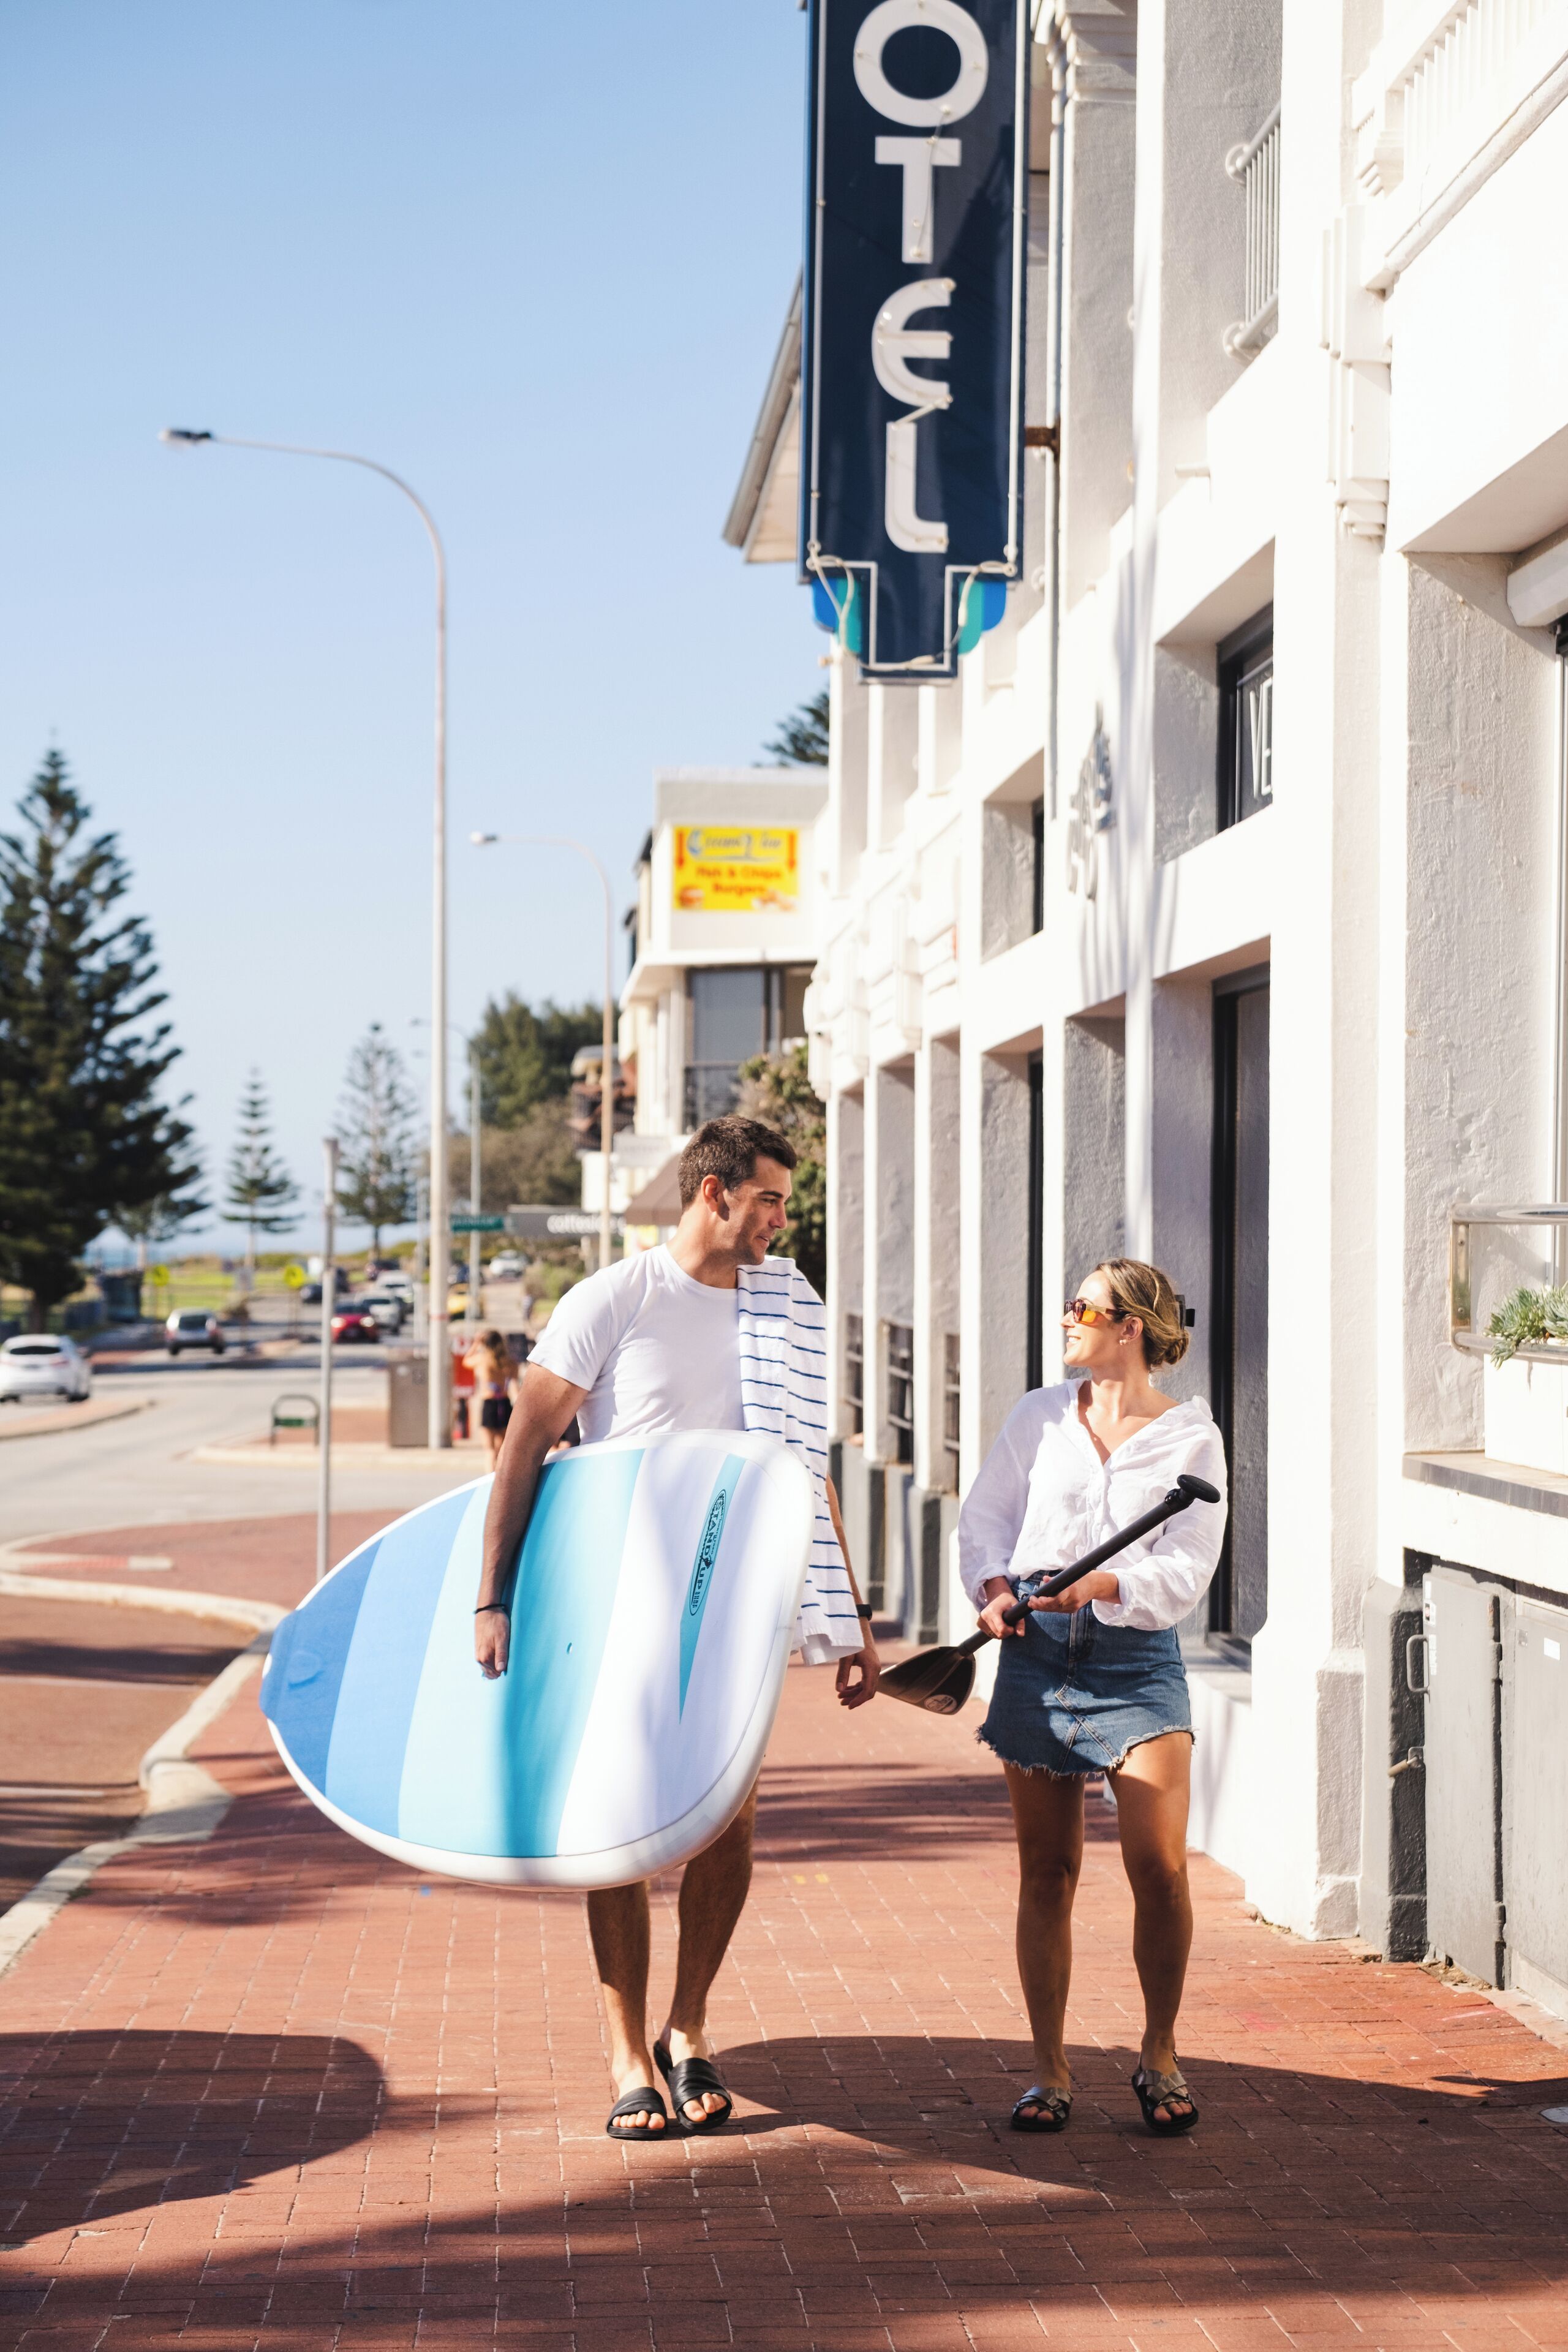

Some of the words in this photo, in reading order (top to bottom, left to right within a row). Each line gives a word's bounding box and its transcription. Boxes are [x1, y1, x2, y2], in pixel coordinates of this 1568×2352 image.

[853, 0, 989, 553] OTEL
[704, 1501, 722, 1556] STAND
[697, 1567, 706, 1590] UP
